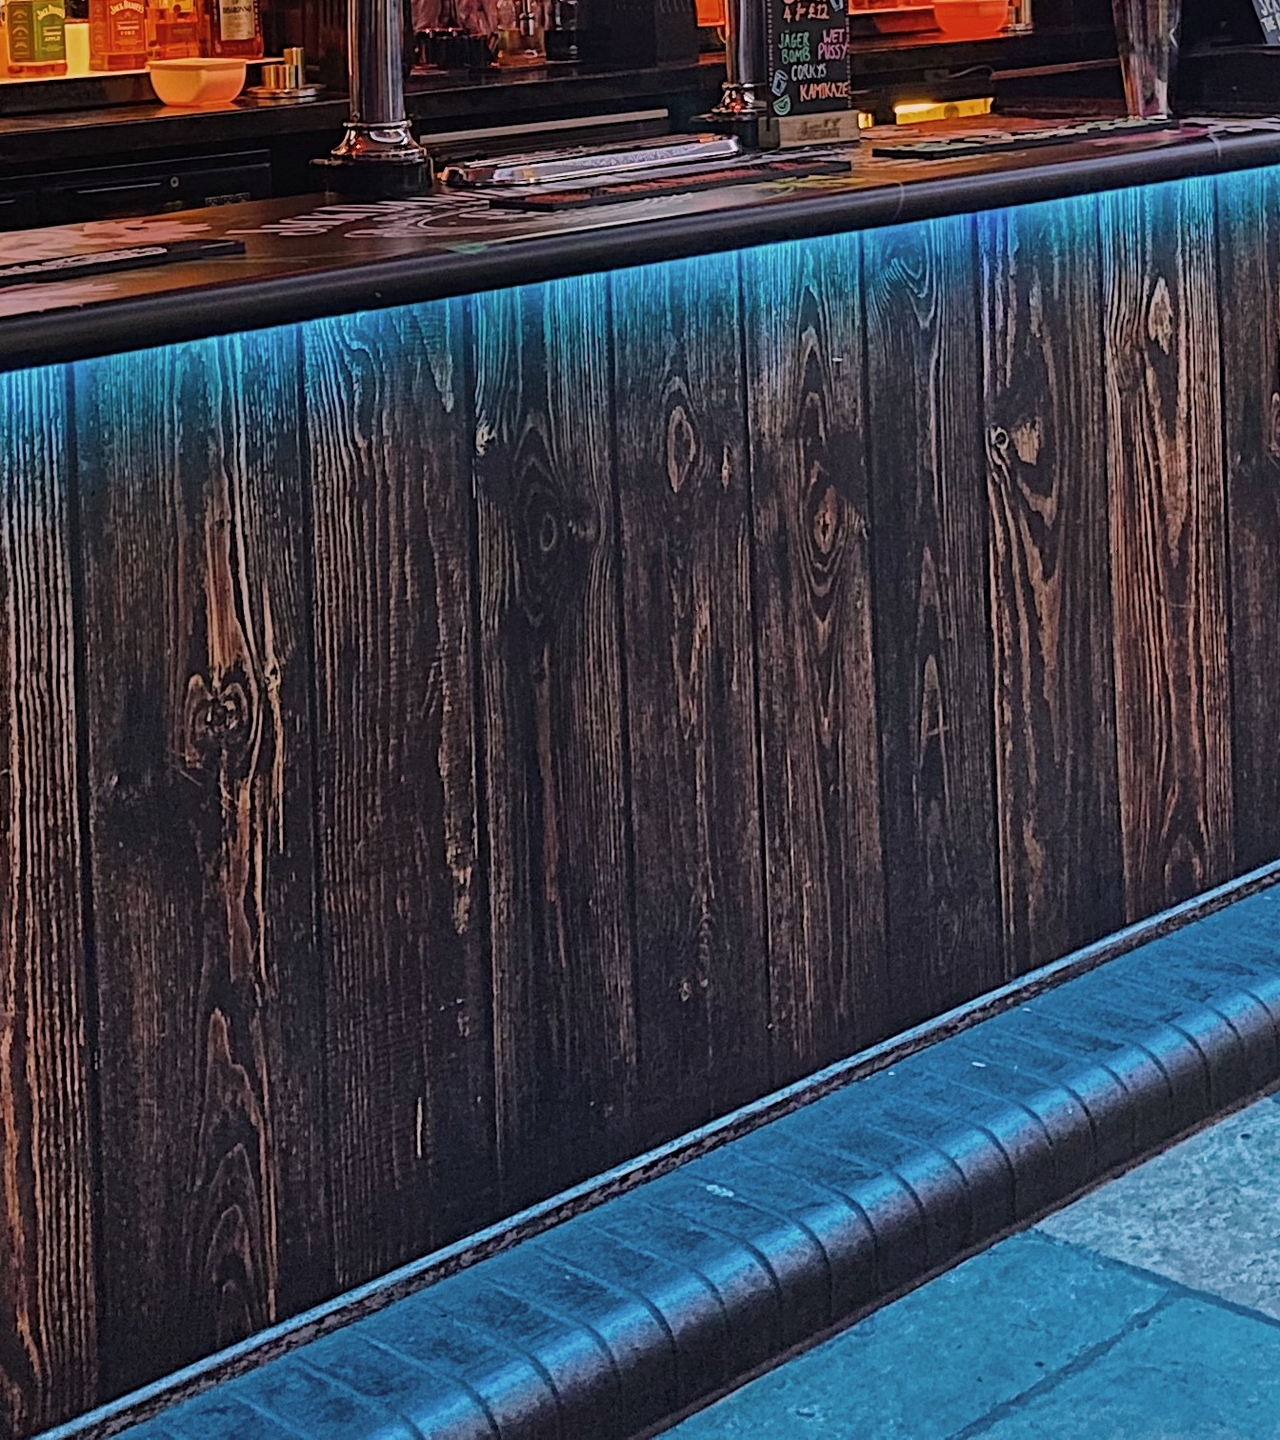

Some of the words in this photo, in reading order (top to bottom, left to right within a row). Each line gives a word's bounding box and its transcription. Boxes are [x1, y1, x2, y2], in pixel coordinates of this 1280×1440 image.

[783, 5, 793, 23] 4
[807, 3, 830, 20] £12
[1260, 16, 1277, 33] THE
[823, 29, 845, 43] WET
[781, 47, 811, 64] BOMB
[817, 42, 849, 61] PUSSY
[799, 82, 849, 102] KAMIKAZE
